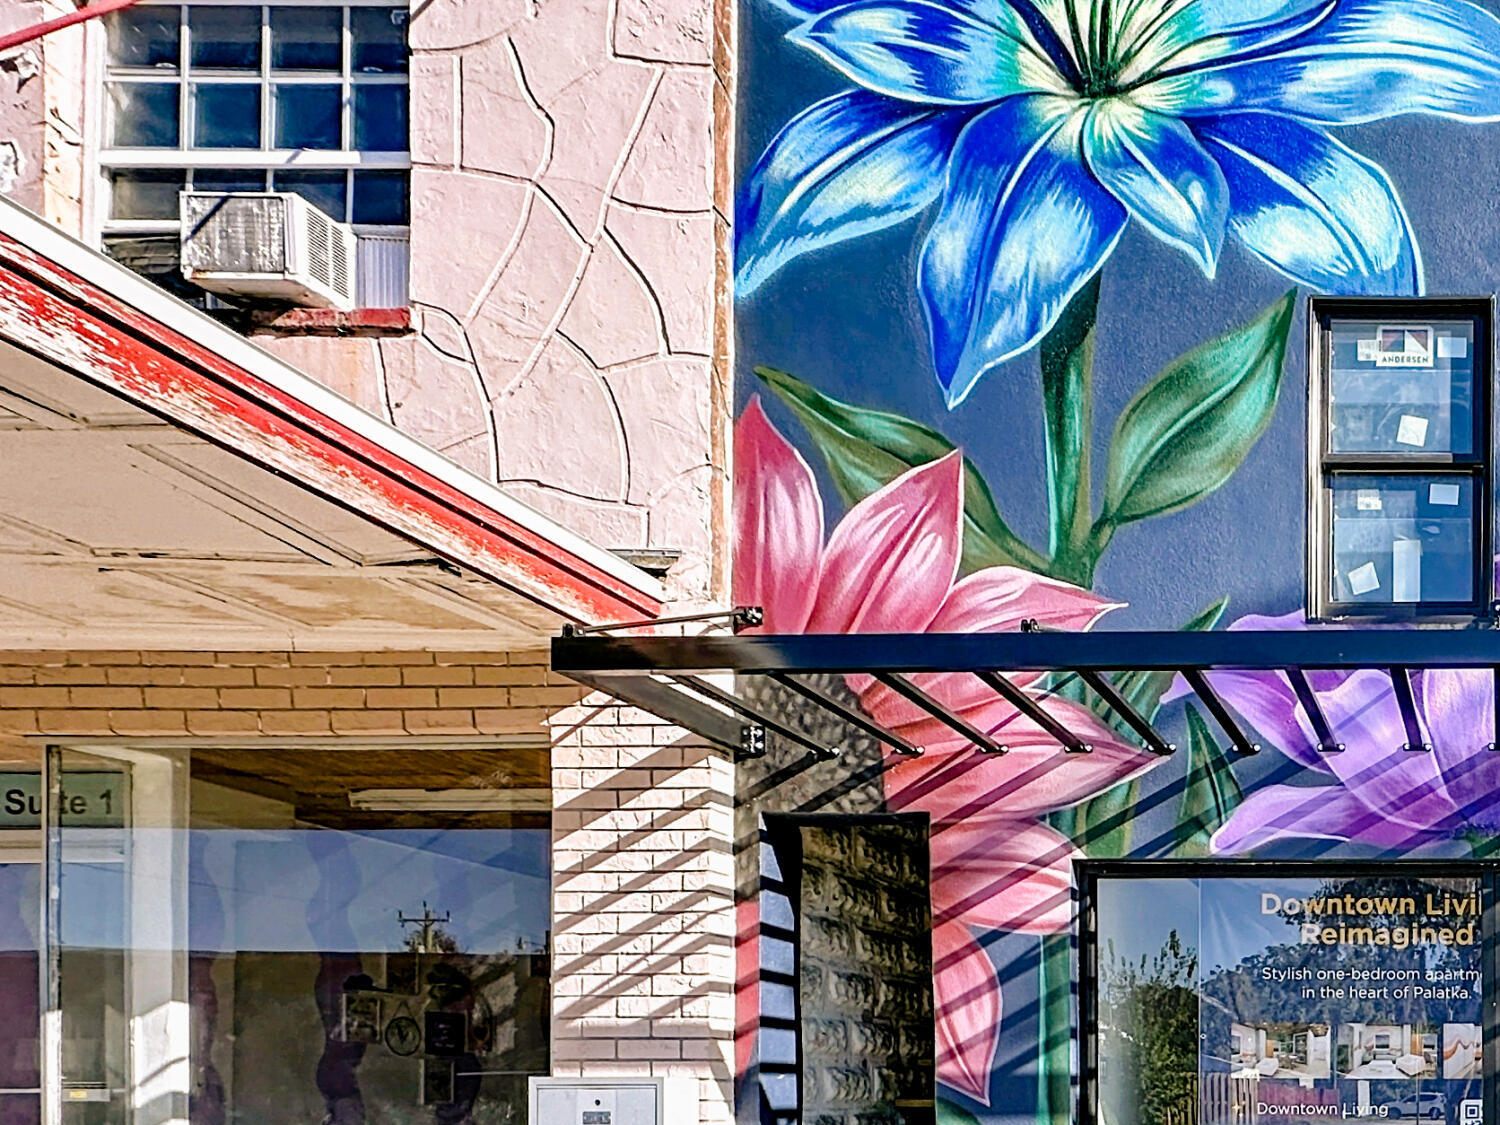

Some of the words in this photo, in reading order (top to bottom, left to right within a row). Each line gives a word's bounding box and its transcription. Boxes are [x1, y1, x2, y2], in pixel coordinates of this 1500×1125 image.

[1381, 356, 1429, 364] ANDERSEN
[5, 789, 87, 815] Sute
[100, 789, 112, 815] 1
[1261, 893, 1415, 915] Downtown
[1301, 922, 1474, 949] Reimagined
[1262, 967, 1312, 982] Stylish
[1317, 966, 1420, 981] one-bedroom
[1302, 985, 1315, 999] in
[1320, 985, 1345, 999] the
[1350, 985, 1389, 999] heart
[1394, 985, 1410, 999] of
[1413, 985, 1472, 999] Palatka.
[1257, 1102, 1338, 1116] Downtown
[1343, 1102, 1389, 1118] Living
